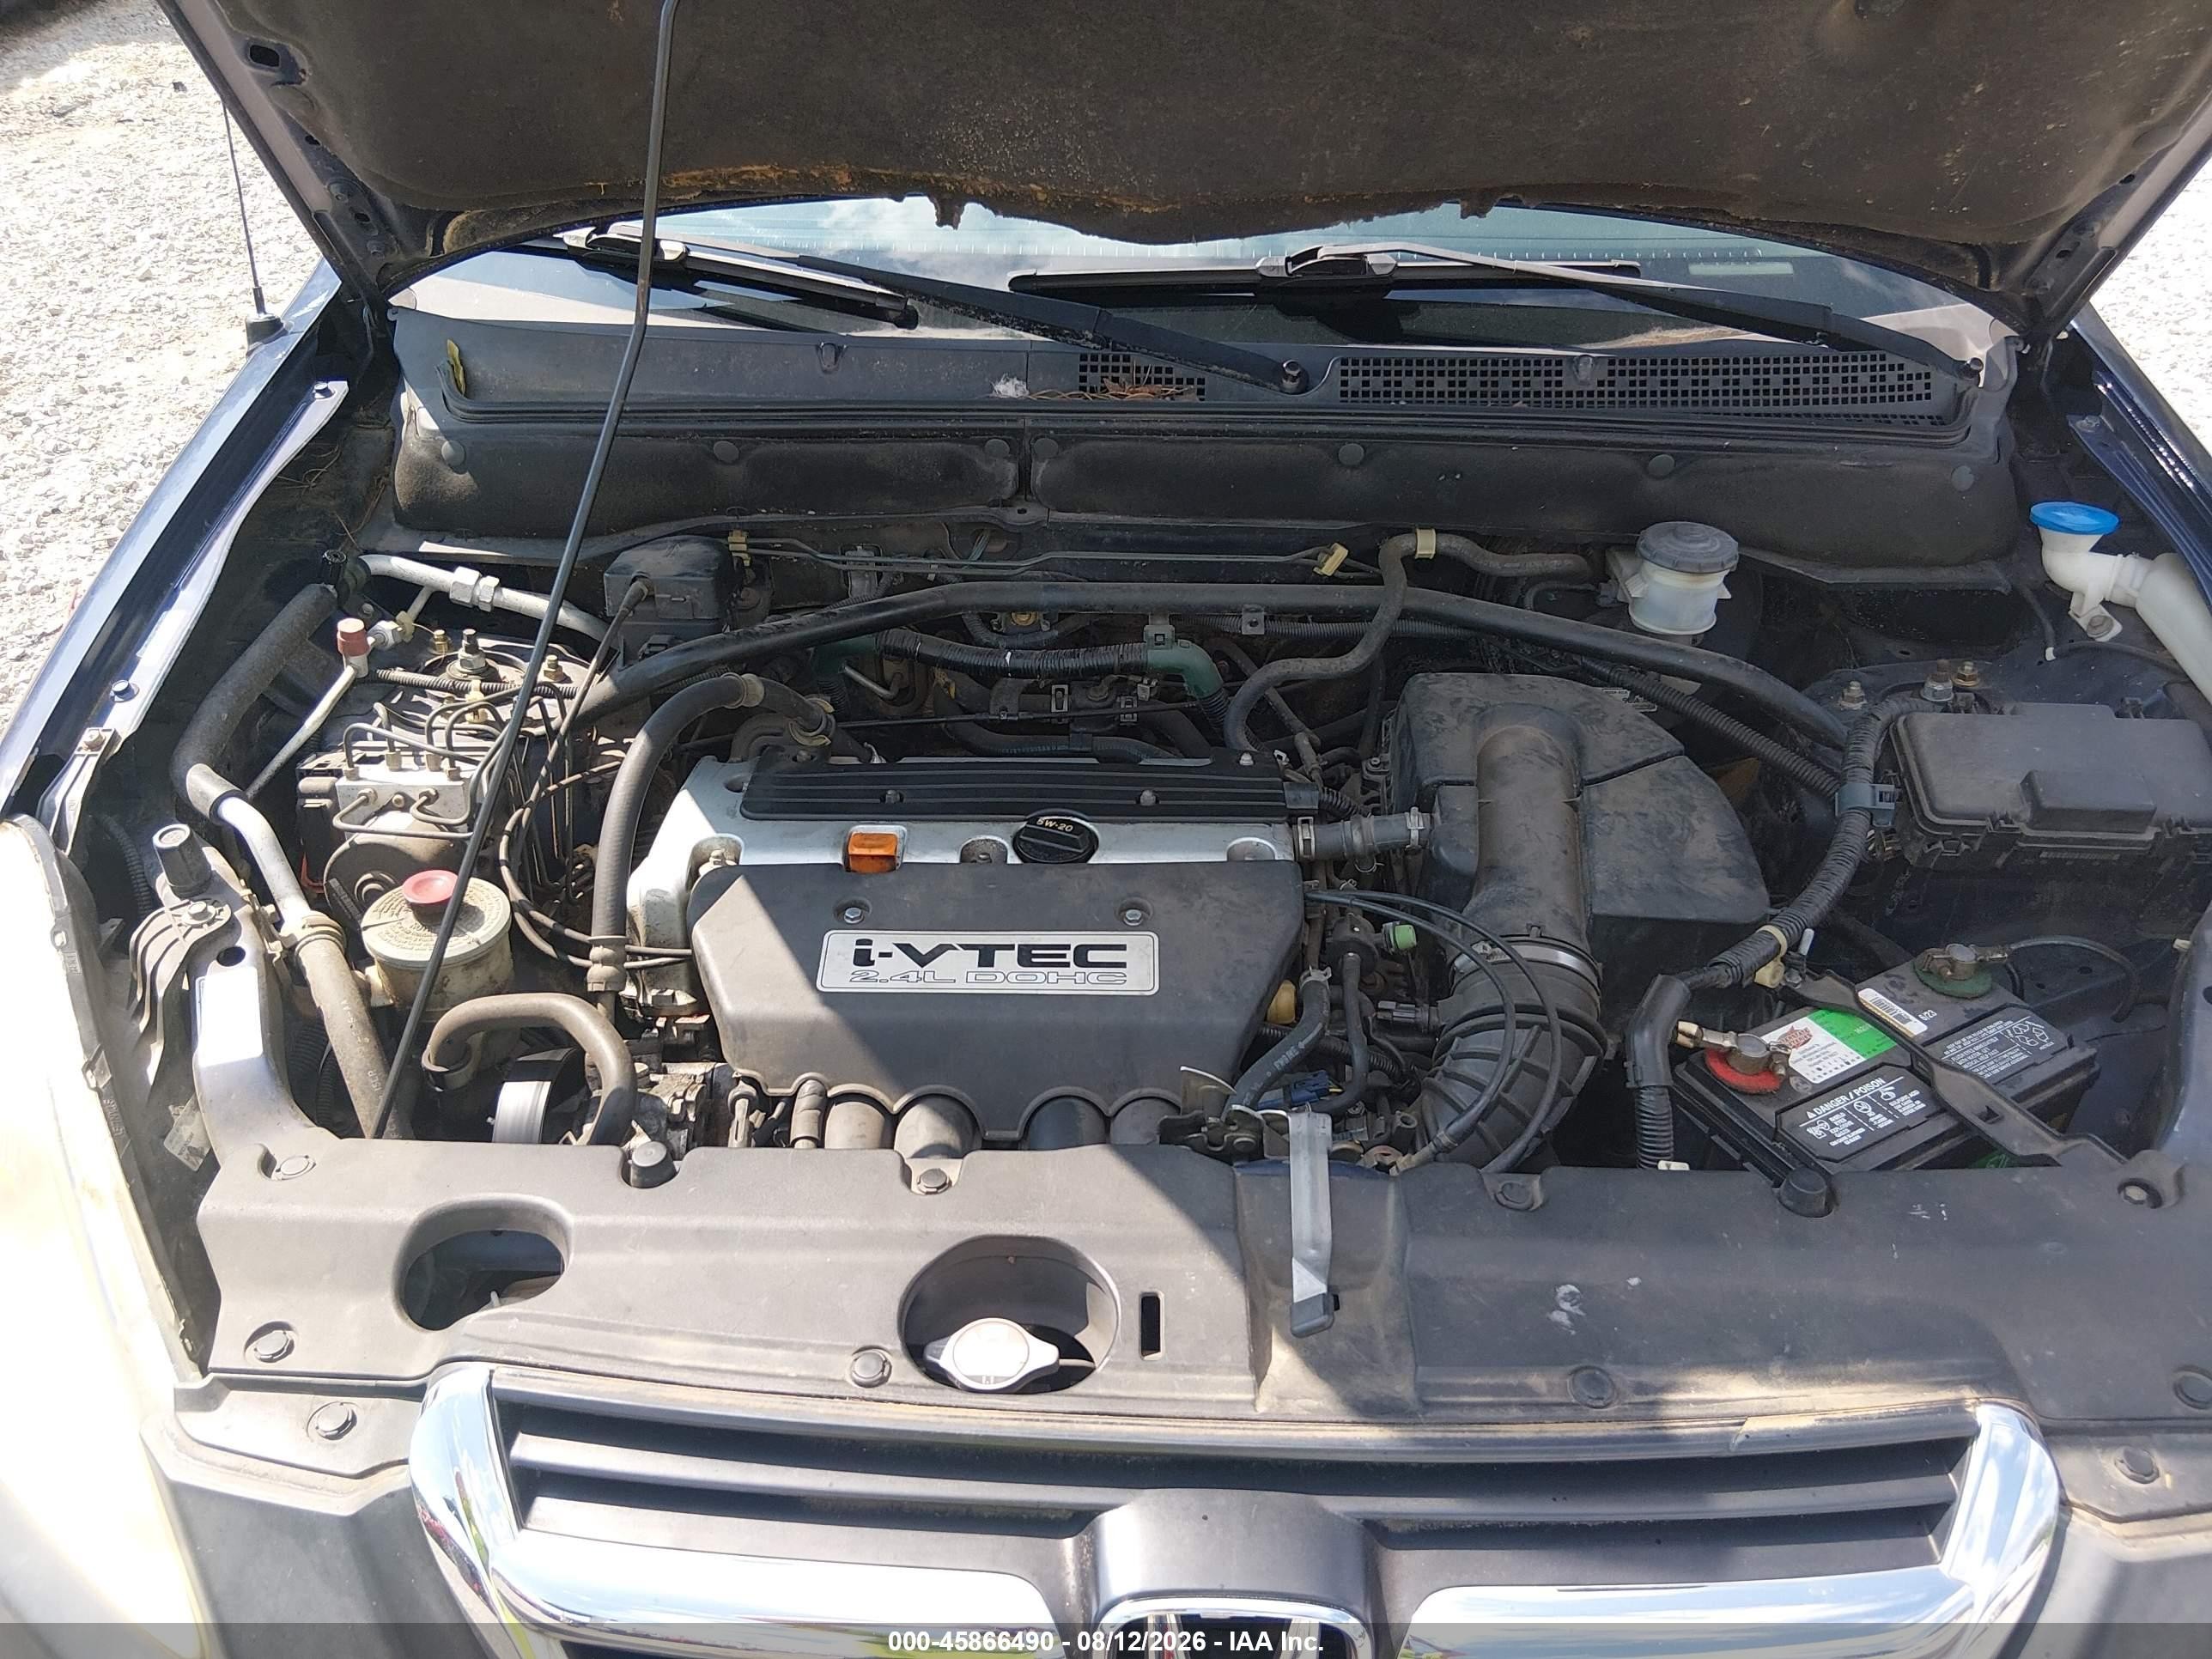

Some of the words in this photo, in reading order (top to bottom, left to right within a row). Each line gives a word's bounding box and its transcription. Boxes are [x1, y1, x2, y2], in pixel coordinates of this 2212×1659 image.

[1036, 818, 1074, 832] 5W-20
[852, 938, 1127, 969] i-VTEC
[849, 969, 957, 983] 2.4L
[965, 970, 1127, 985] DOHC
[1813, 1095, 1850, 1115] DANGER
[1853, 1077, 1887, 1097] POISON
